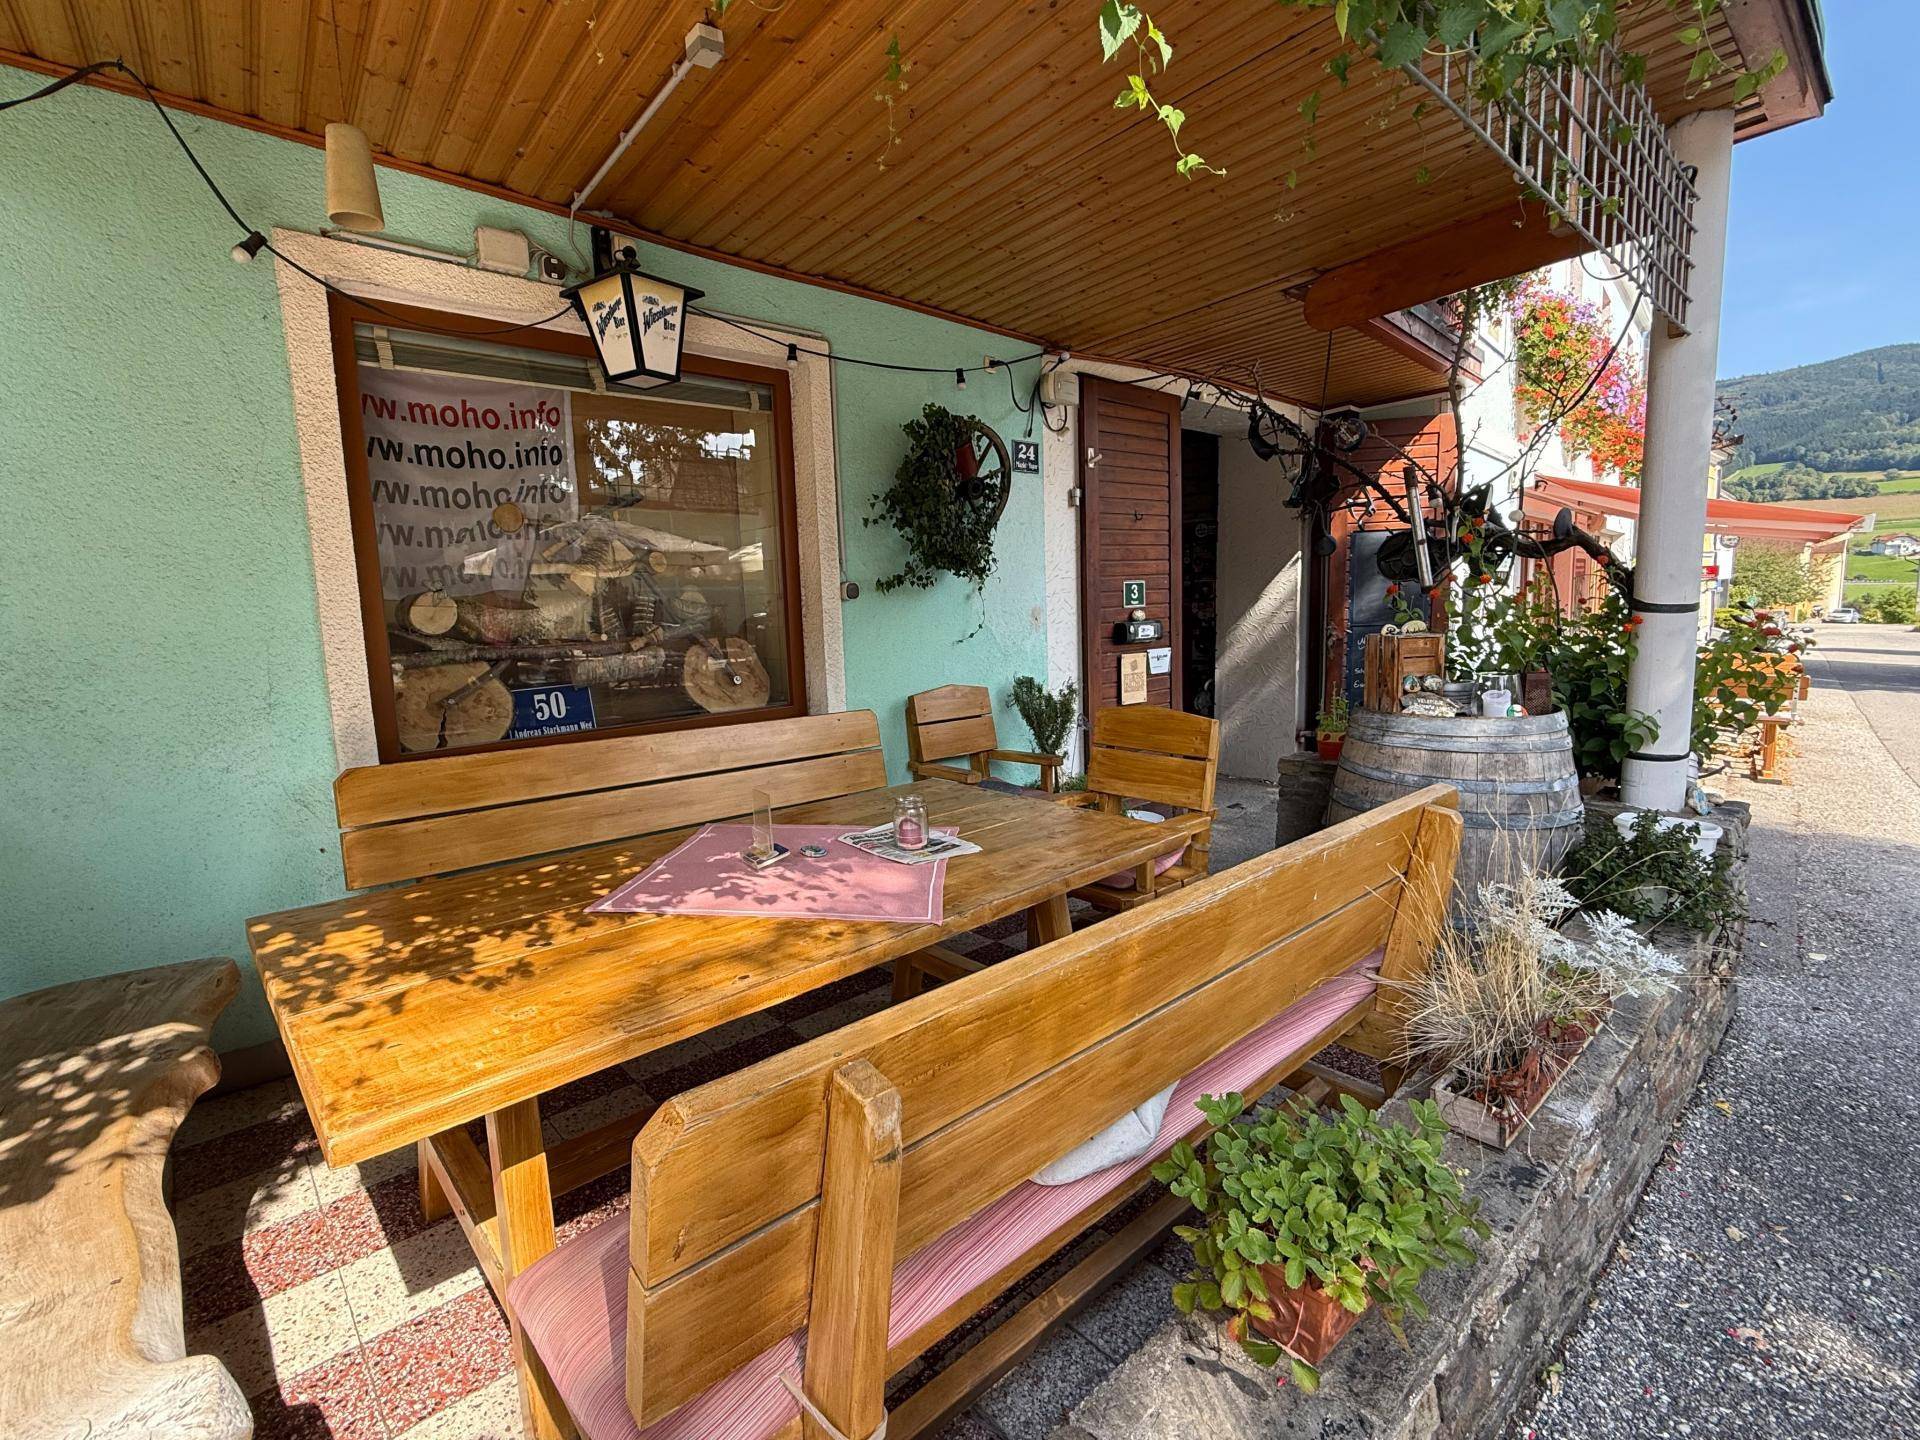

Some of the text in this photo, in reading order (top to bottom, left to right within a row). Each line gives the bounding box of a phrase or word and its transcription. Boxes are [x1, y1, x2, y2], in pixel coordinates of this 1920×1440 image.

[1018, 444, 1035, 461] 24
[1131, 584, 1139, 599] 3
[533, 691, 567, 721] 50
[514, 728, 542, 740] Andreas
[543, 723, 579, 735] Starkmann
